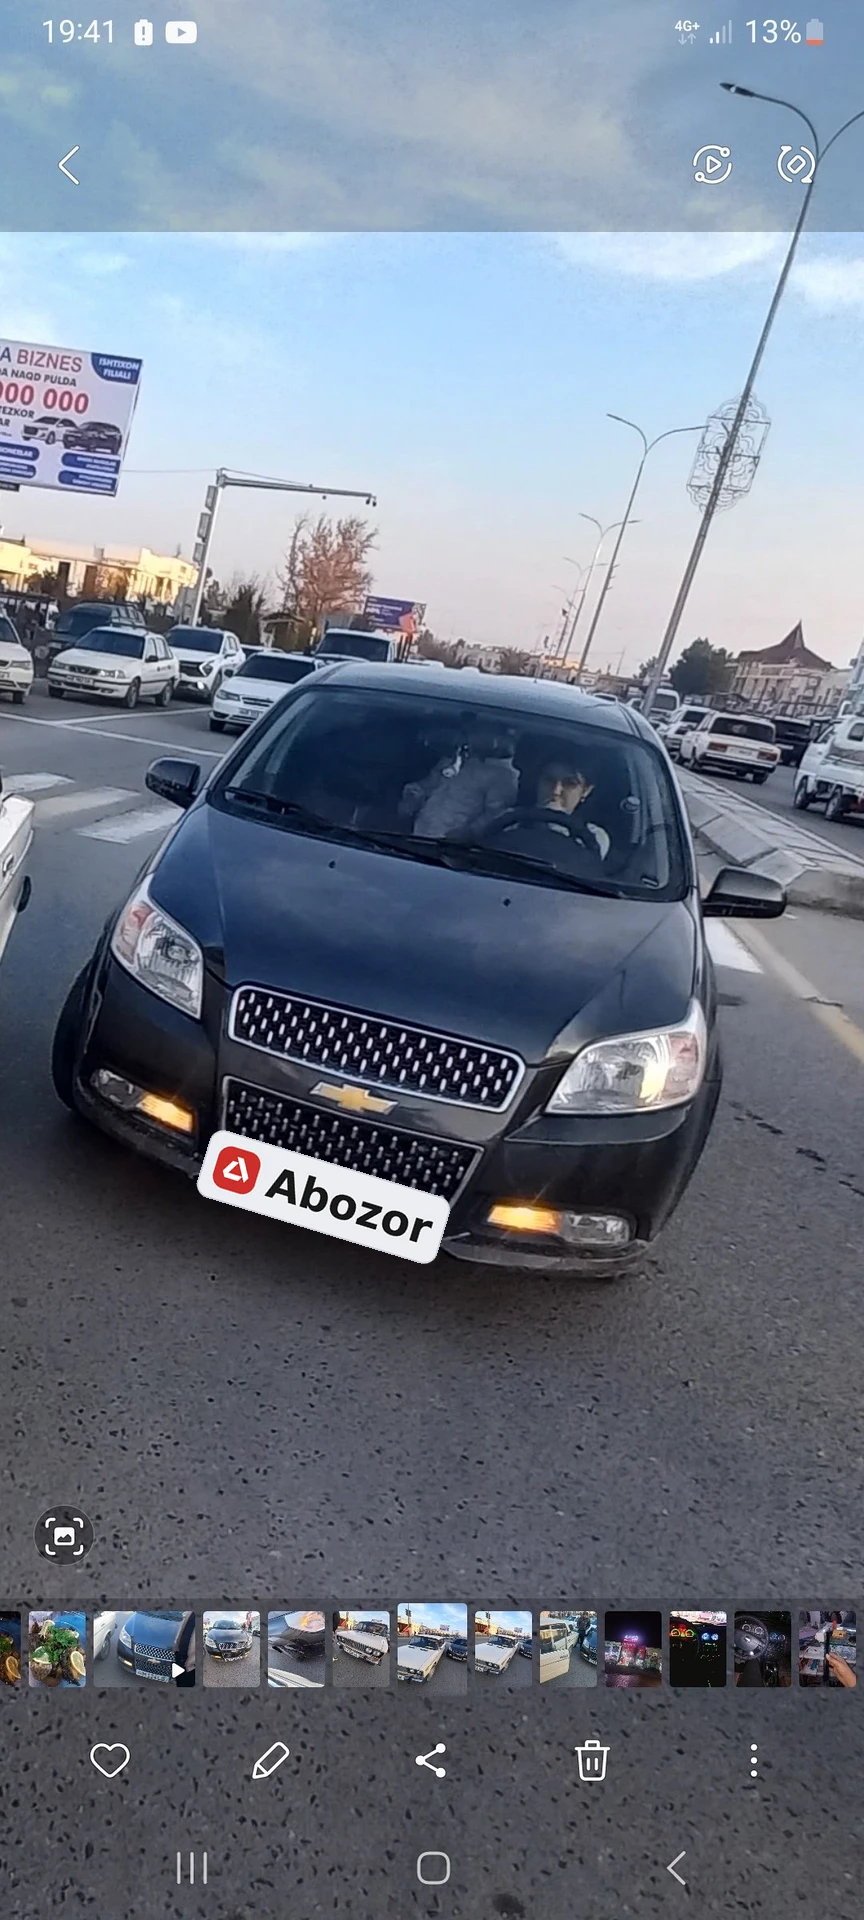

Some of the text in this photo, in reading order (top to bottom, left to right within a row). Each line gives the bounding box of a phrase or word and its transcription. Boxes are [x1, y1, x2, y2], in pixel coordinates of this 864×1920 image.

[17, 349, 83, 373] BIZNES
[99, 357, 140, 371] ISHTIXON
[11, 368, 42, 382] NAQD
[44, 374, 77, 387] PULDA
[103, 368, 132, 380] FILIALI
[43, 388, 89, 414] 000
[0, 405, 35, 419] EZKOR
